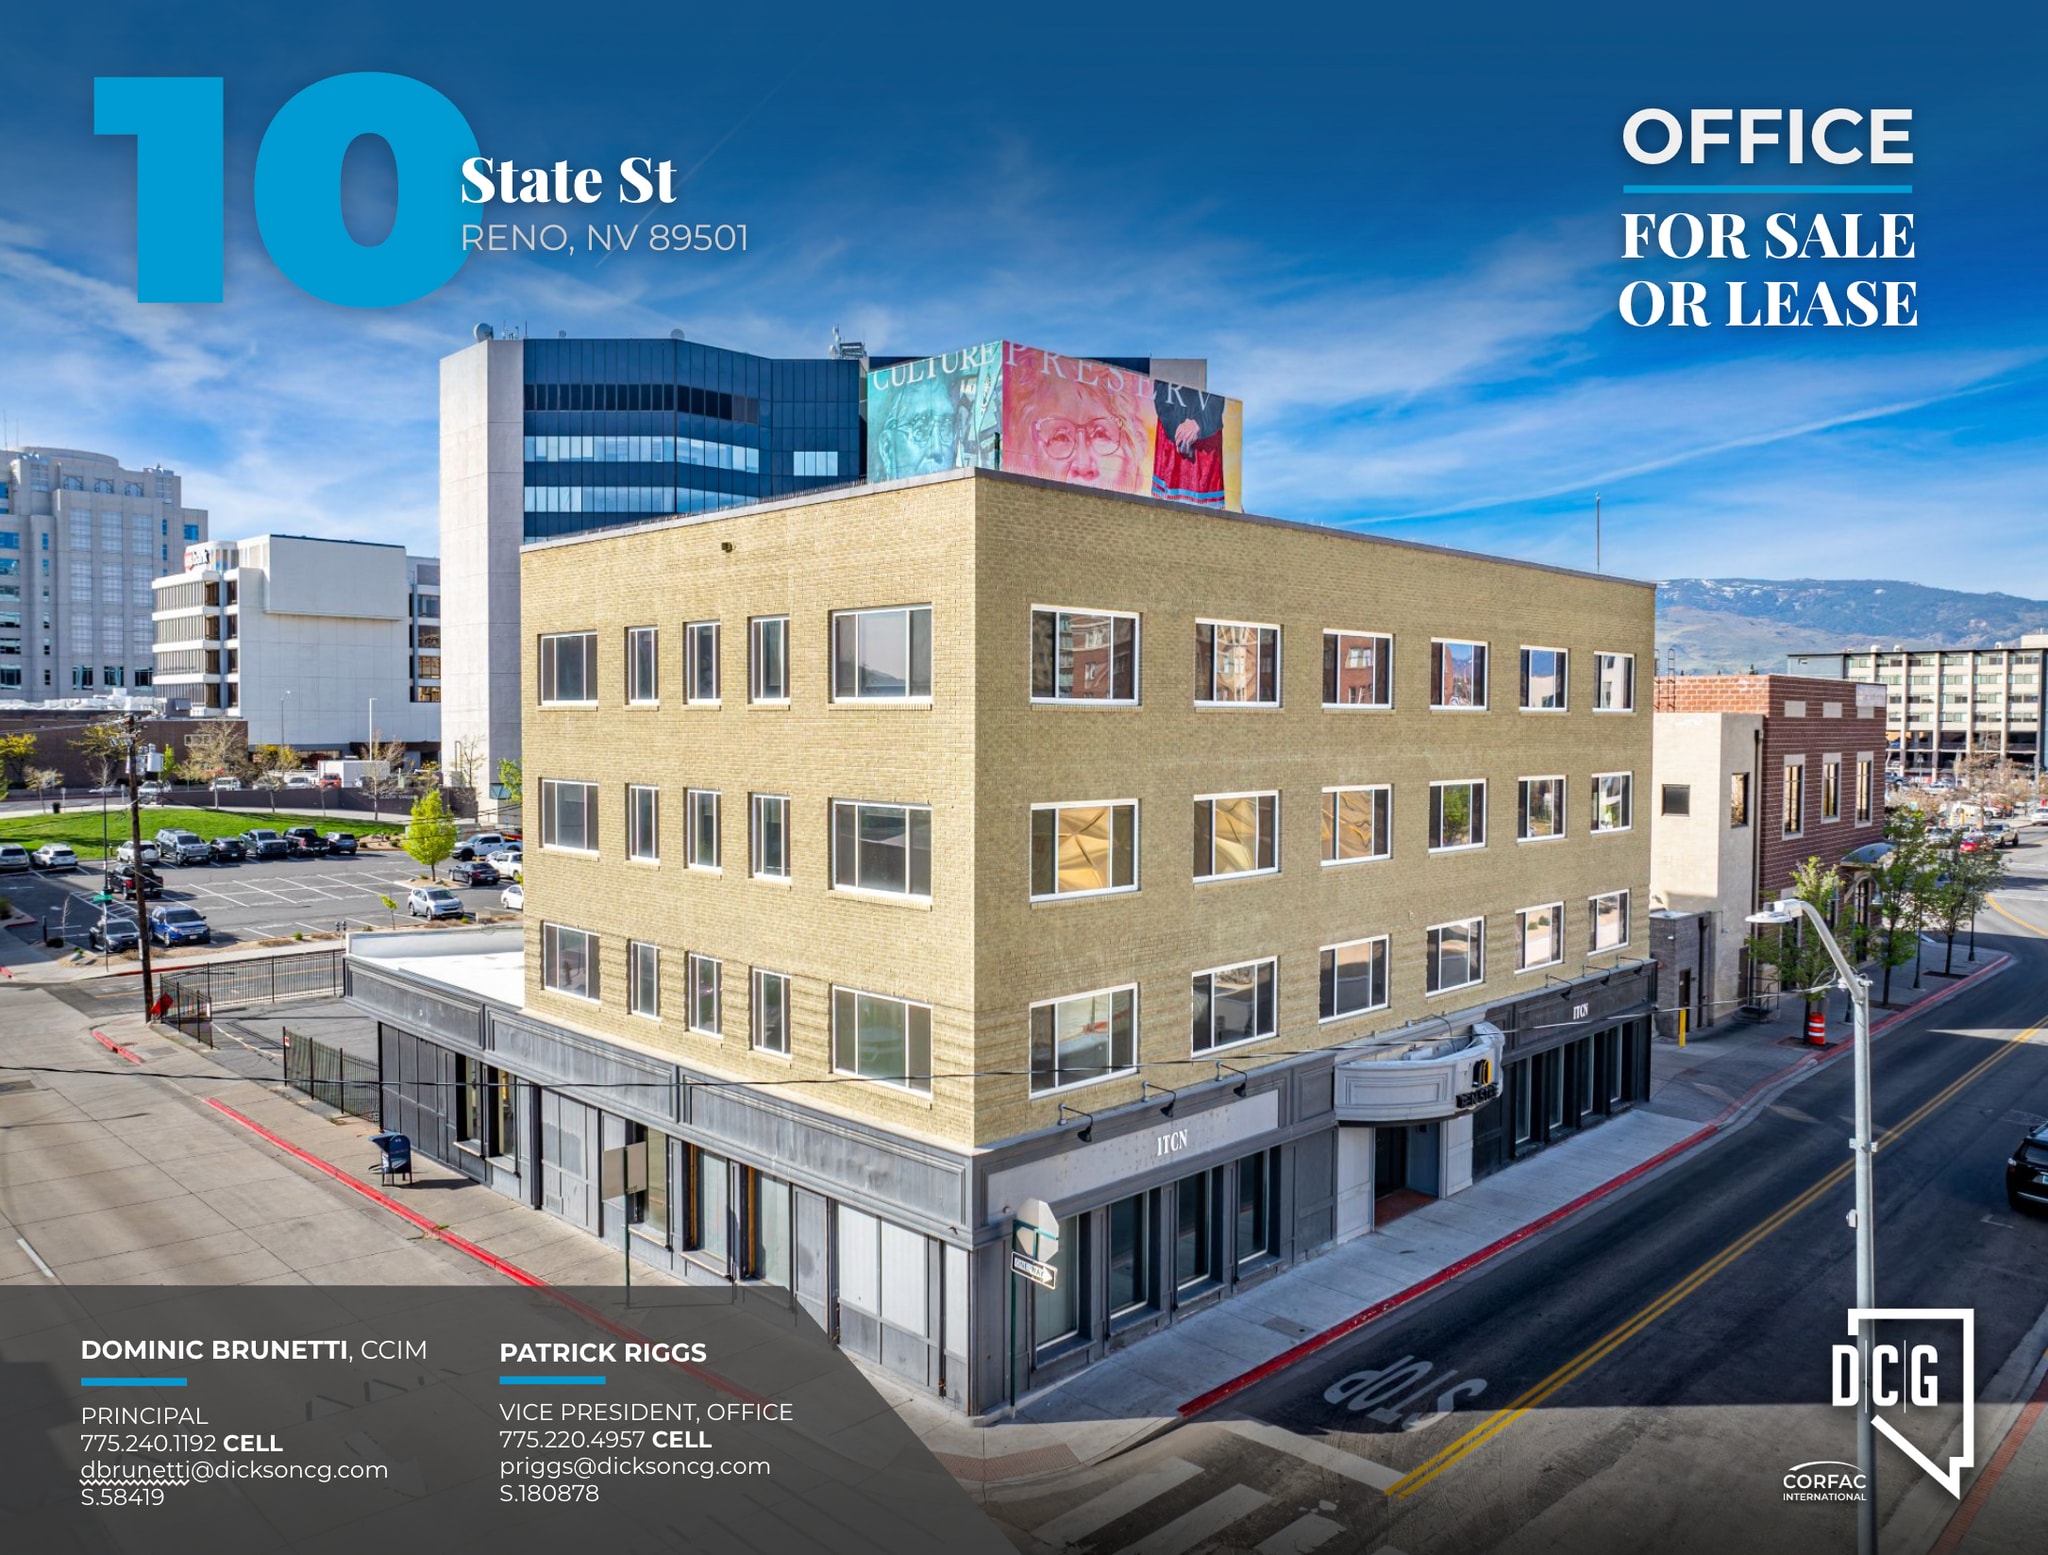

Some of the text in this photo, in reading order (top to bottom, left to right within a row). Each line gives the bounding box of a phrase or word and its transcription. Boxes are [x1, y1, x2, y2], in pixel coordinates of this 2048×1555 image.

[873, 341, 995, 390] CULTURE
[1156, 1128, 1189, 1158] ITCN
[1324, 1354, 1488, 1432] STOP
